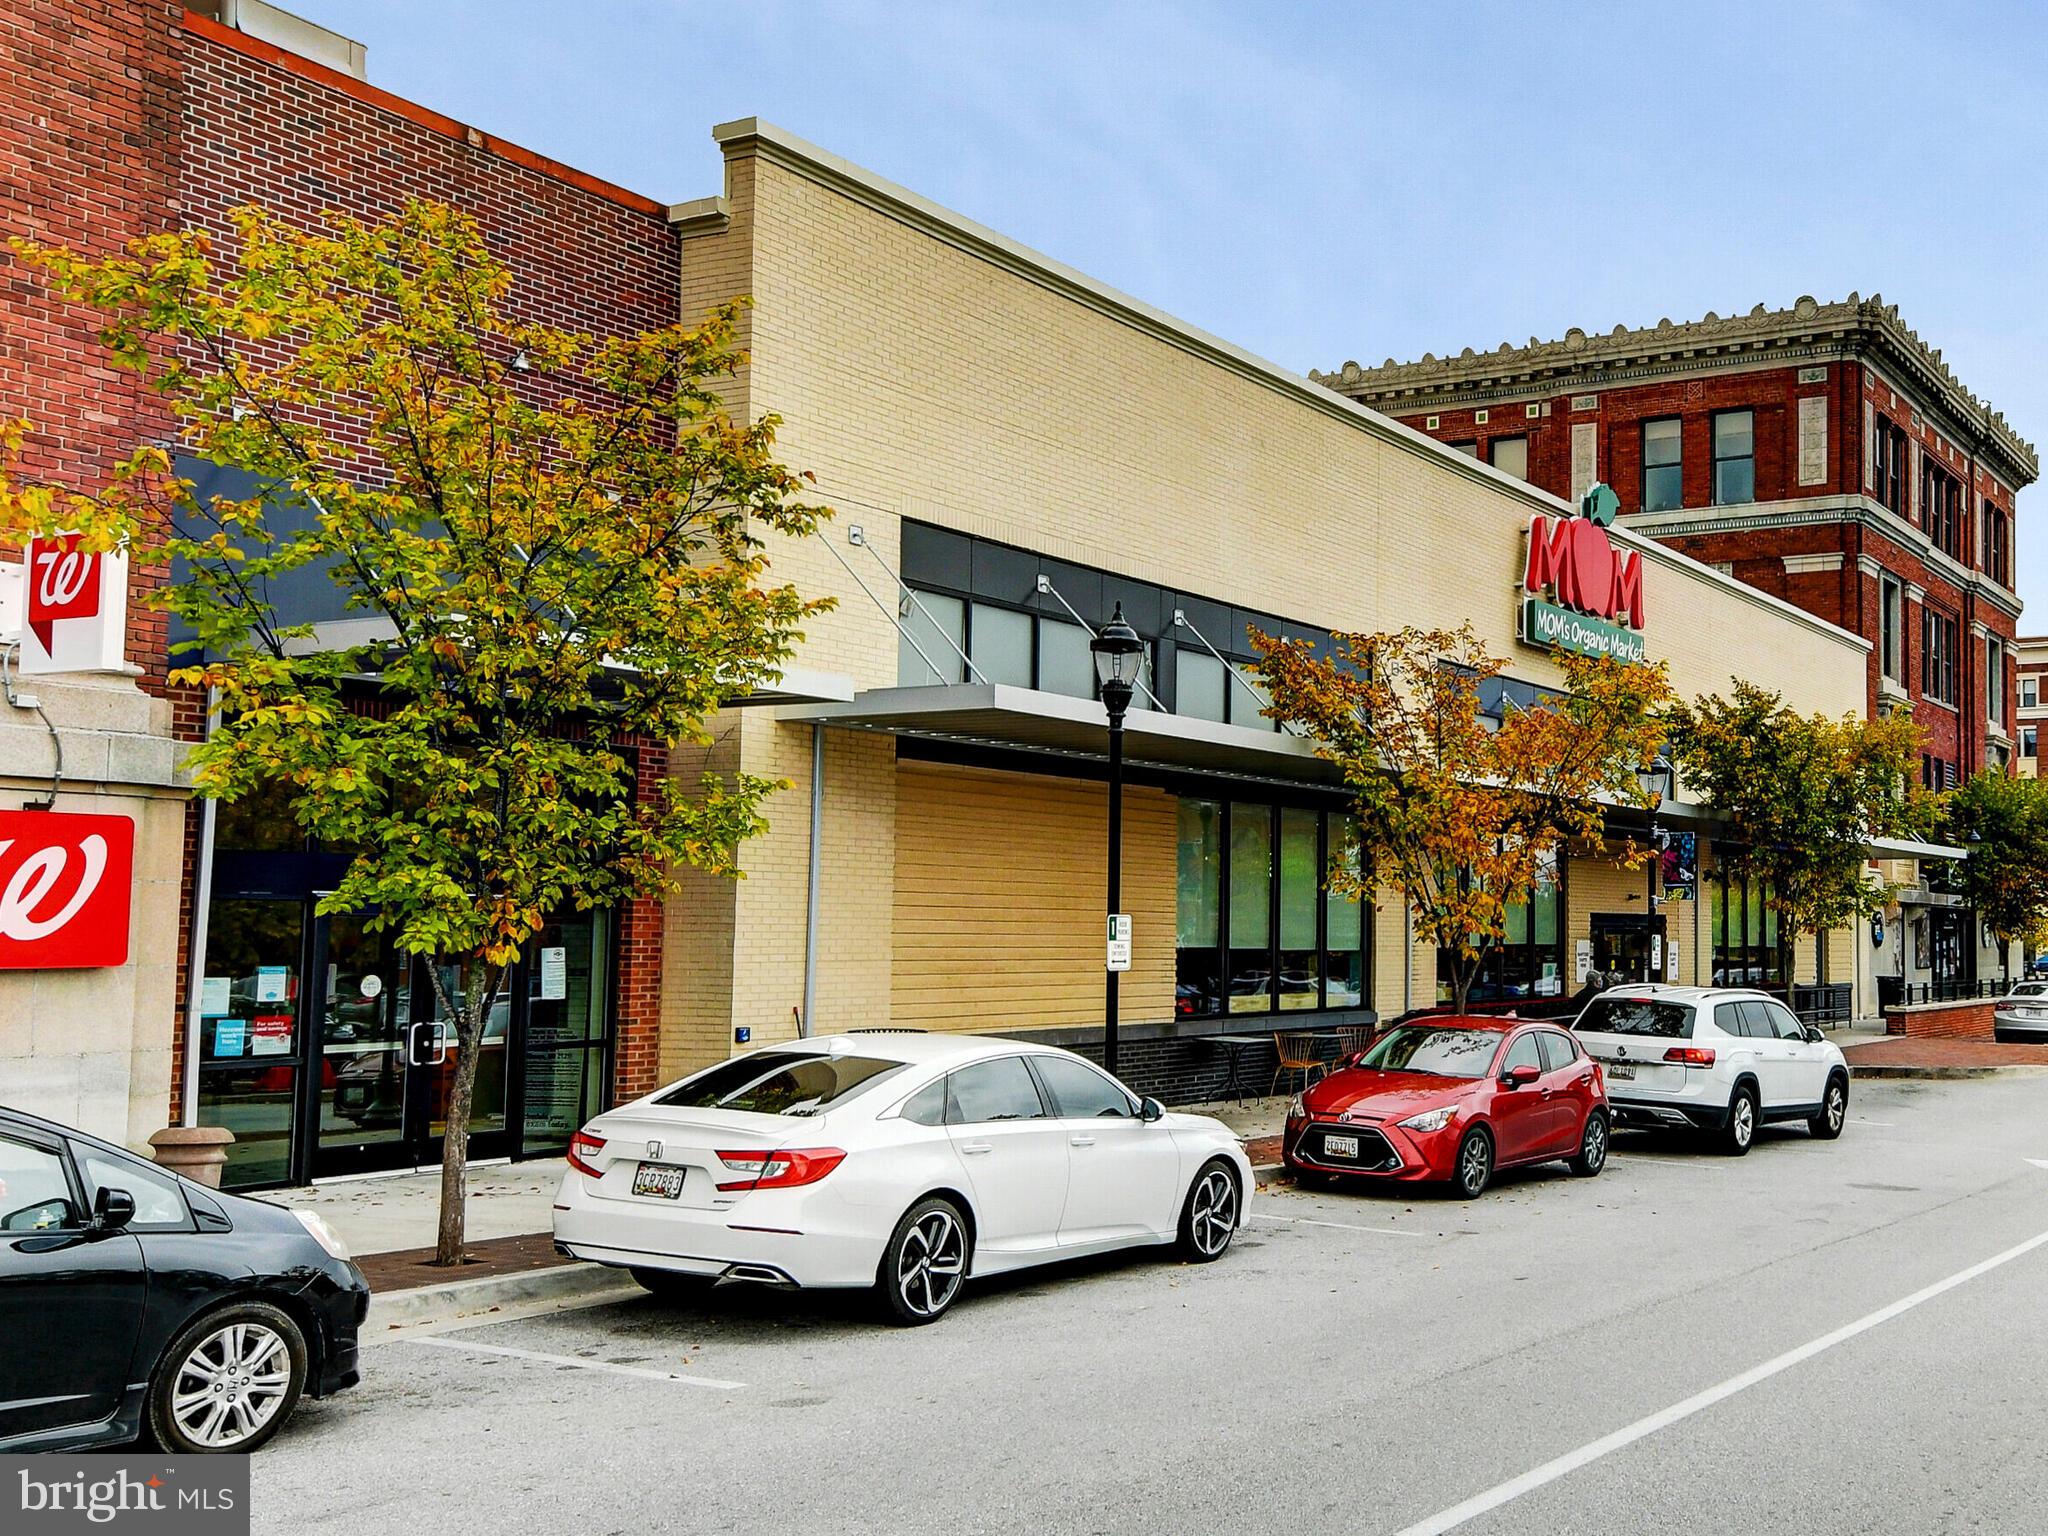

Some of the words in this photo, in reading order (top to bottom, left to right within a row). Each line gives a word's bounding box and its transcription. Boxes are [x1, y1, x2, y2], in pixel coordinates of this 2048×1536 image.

[1525, 516, 1645, 630] MOM
[1537, 609, 1570, 640] MOM's
[1571, 621, 1609, 651] Organic
[1610, 634, 1644, 663] Market
